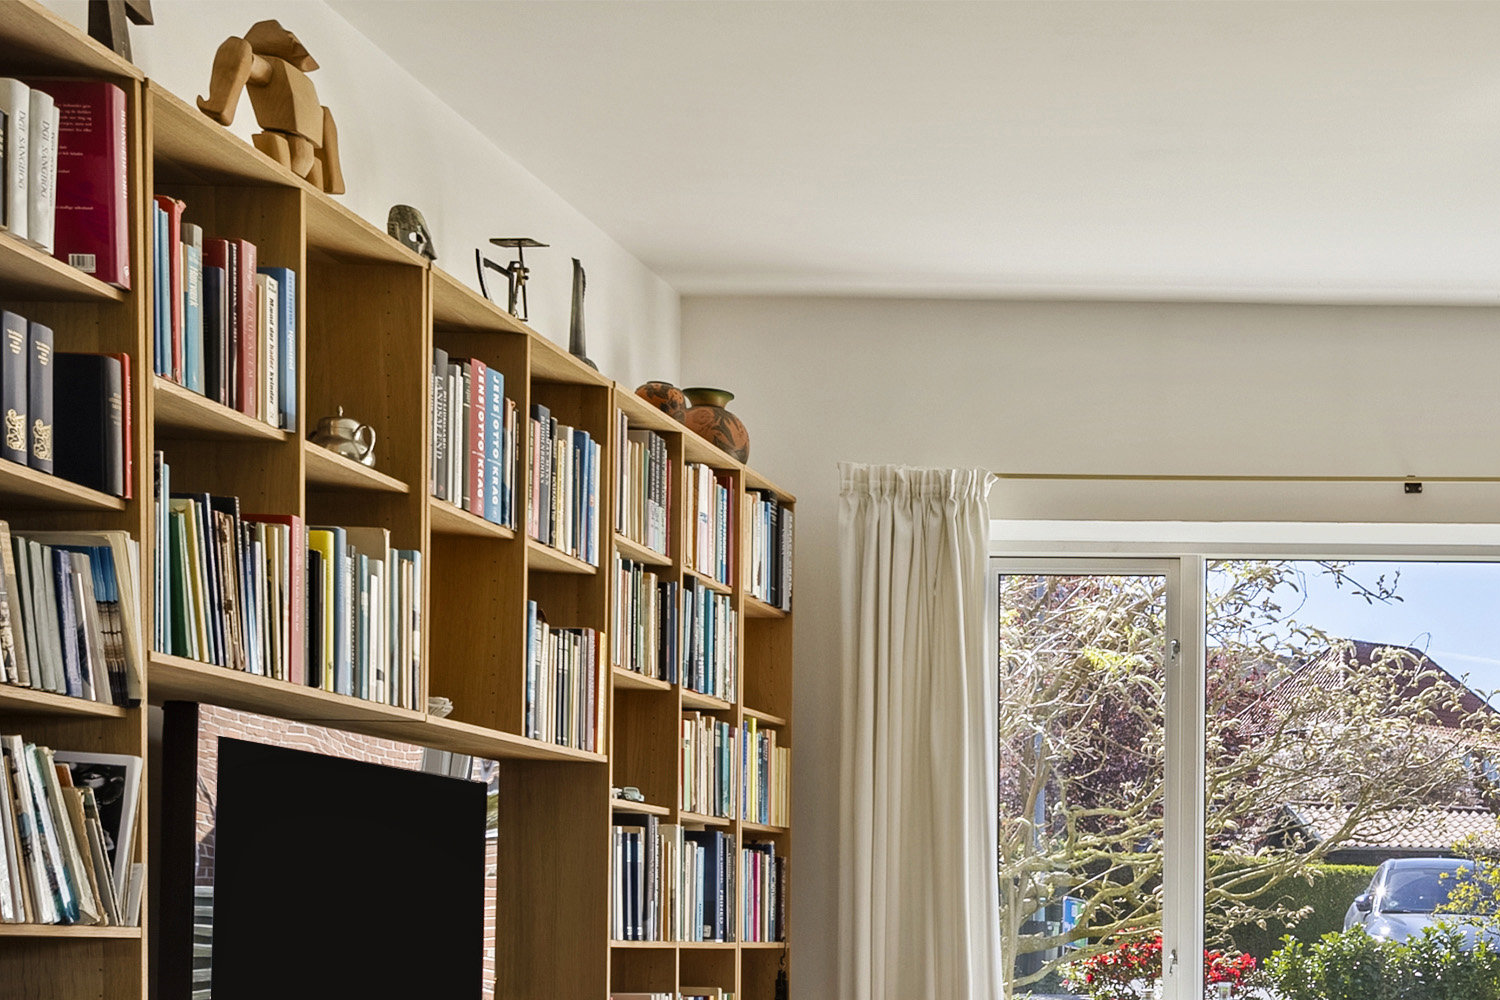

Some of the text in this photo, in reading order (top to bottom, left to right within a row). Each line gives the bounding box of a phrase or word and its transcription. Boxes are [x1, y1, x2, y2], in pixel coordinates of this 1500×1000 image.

[476, 366, 485, 499] JENS OTTO KRAG
[491, 375, 500, 506] JENS OTTO KRAG
